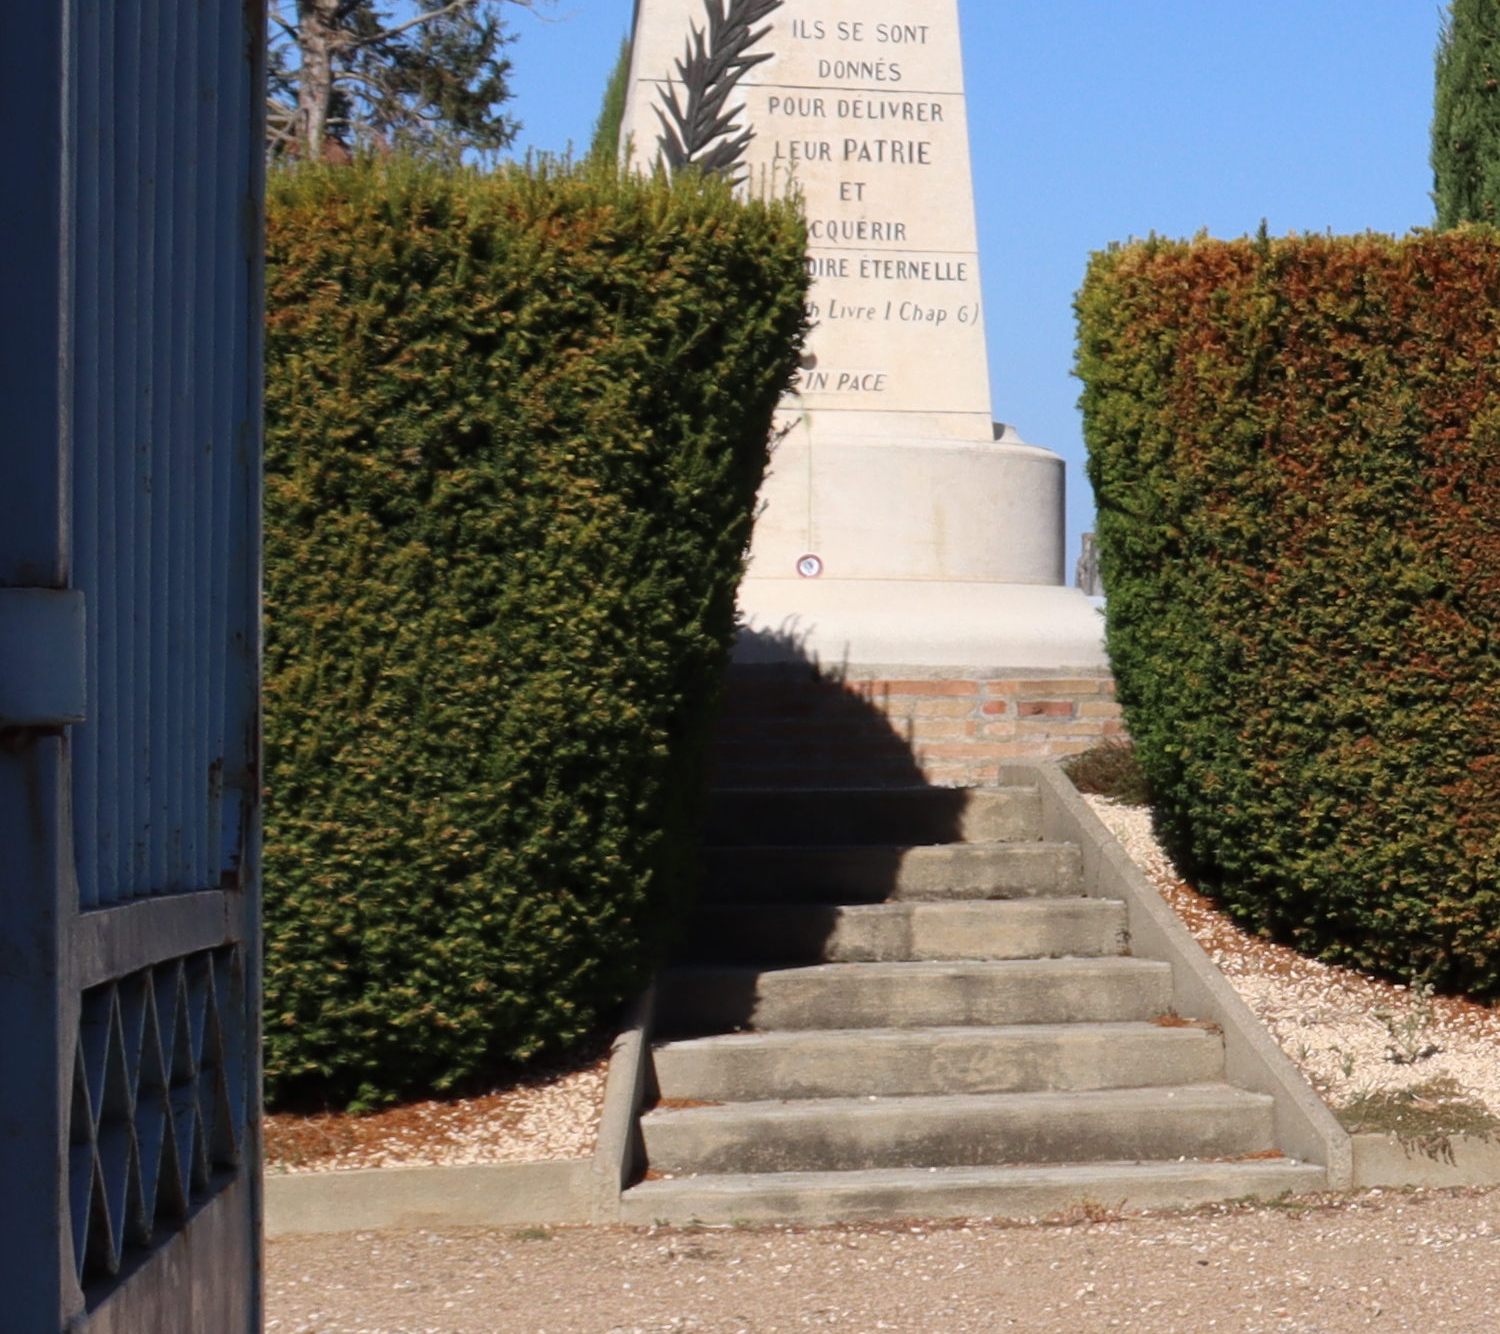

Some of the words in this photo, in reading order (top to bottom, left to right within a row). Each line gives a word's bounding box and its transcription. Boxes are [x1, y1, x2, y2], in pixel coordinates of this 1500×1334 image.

[792, 19, 825, 40] ILS
[837, 21, 863, 42] SE
[876, 24, 929, 44] SONT
[818, 57, 901, 81] DONNÉS
[768, 96, 826, 118] POUR
[837, 94, 943, 122] DÉLIVRER
[775, 140, 832, 162] LEUR
[843, 138, 932, 165] PATRIE
[840, 181, 866, 201] ET
[808, 215, 907, 243] CQUÉRIR
[859, 255, 968, 282] ÉTERNELLE
[829, 298, 876, 321] Livre
[899, 301, 947, 326] Chap
[957, 302, 980, 326] 6)
[805, 371, 829, 391] IN
[836, 372, 888, 392] PACE
